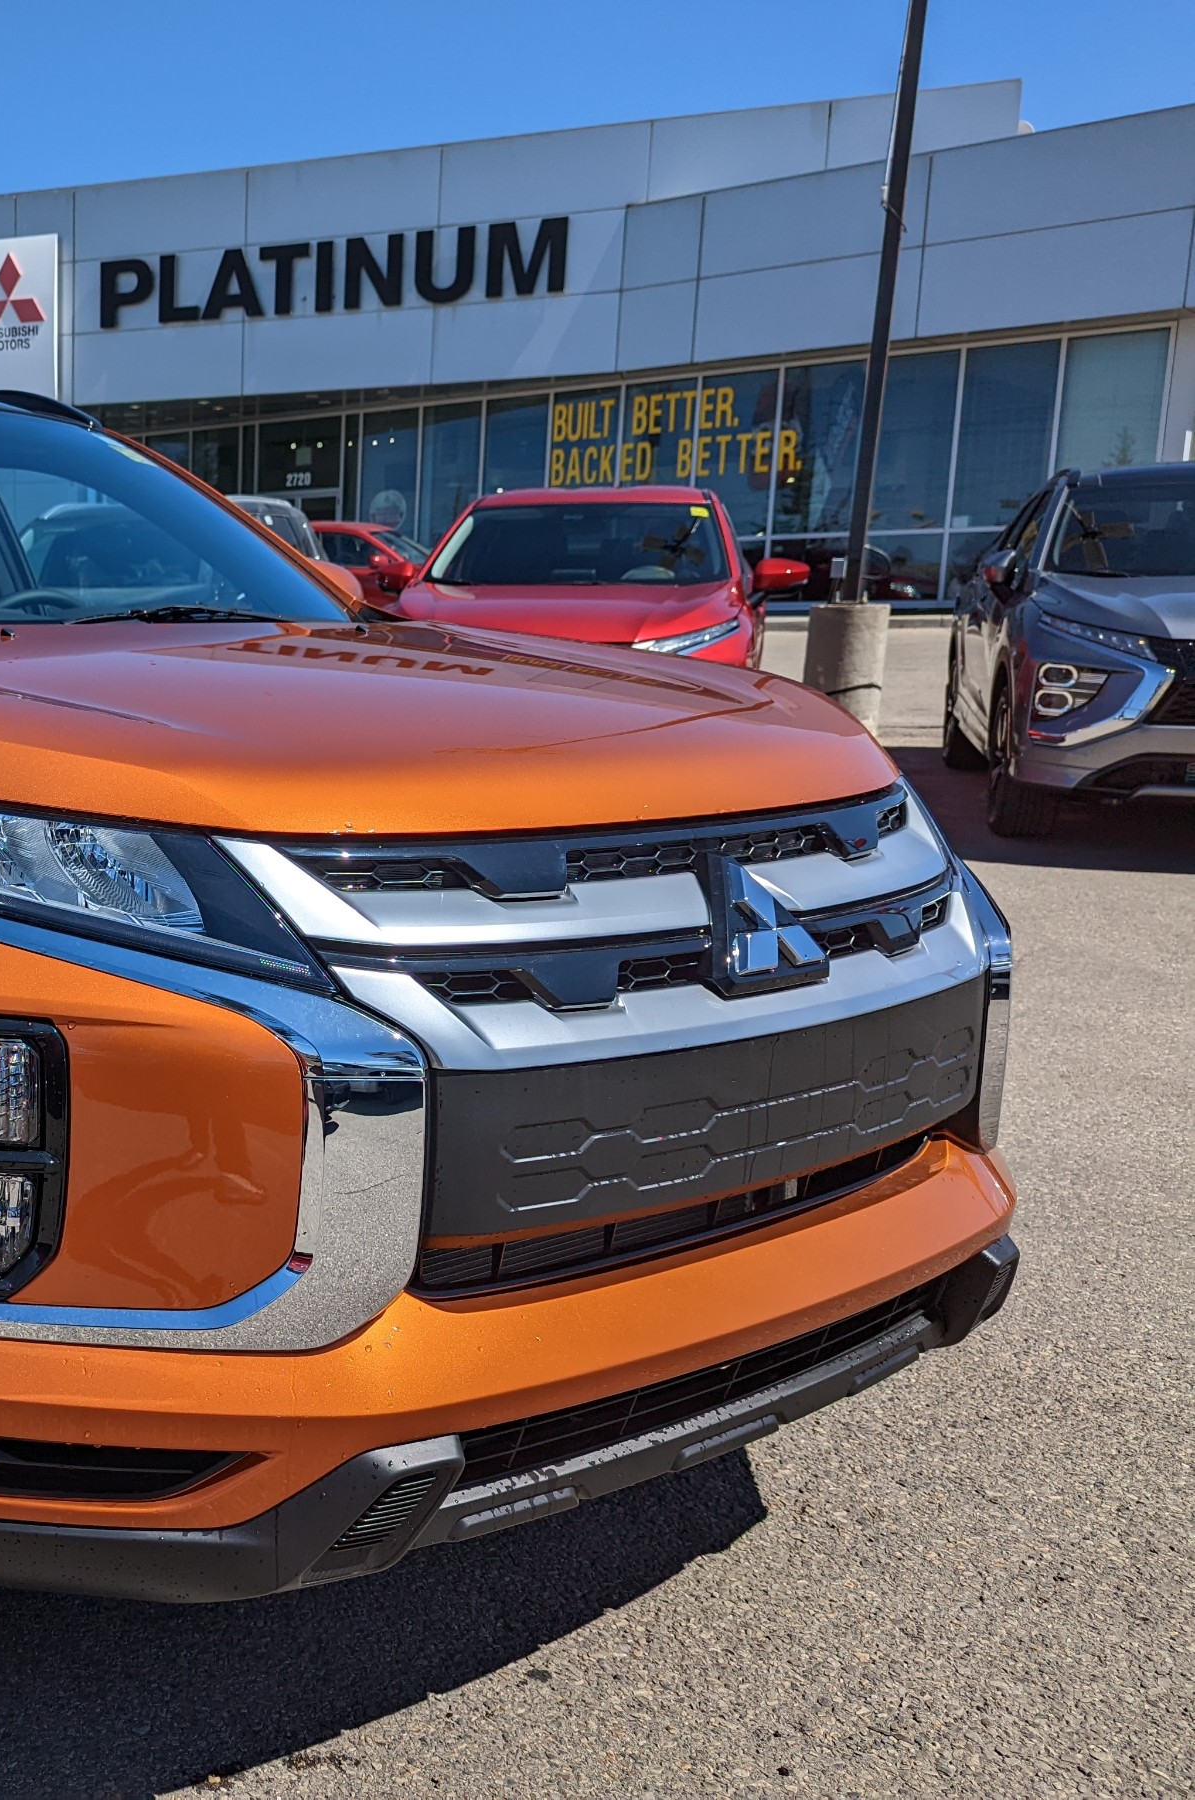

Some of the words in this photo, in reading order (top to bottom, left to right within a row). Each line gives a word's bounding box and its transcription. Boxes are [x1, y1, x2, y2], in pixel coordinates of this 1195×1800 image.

[100, 216, 569, 328] PLATINUM
[553, 399, 616, 442] BUILT
[631, 386, 740, 436] BETTER.
[285, 471, 312, 487] 2720
[550, 440, 653, 487] BACKED
[676, 429, 803, 479] BETTER.
